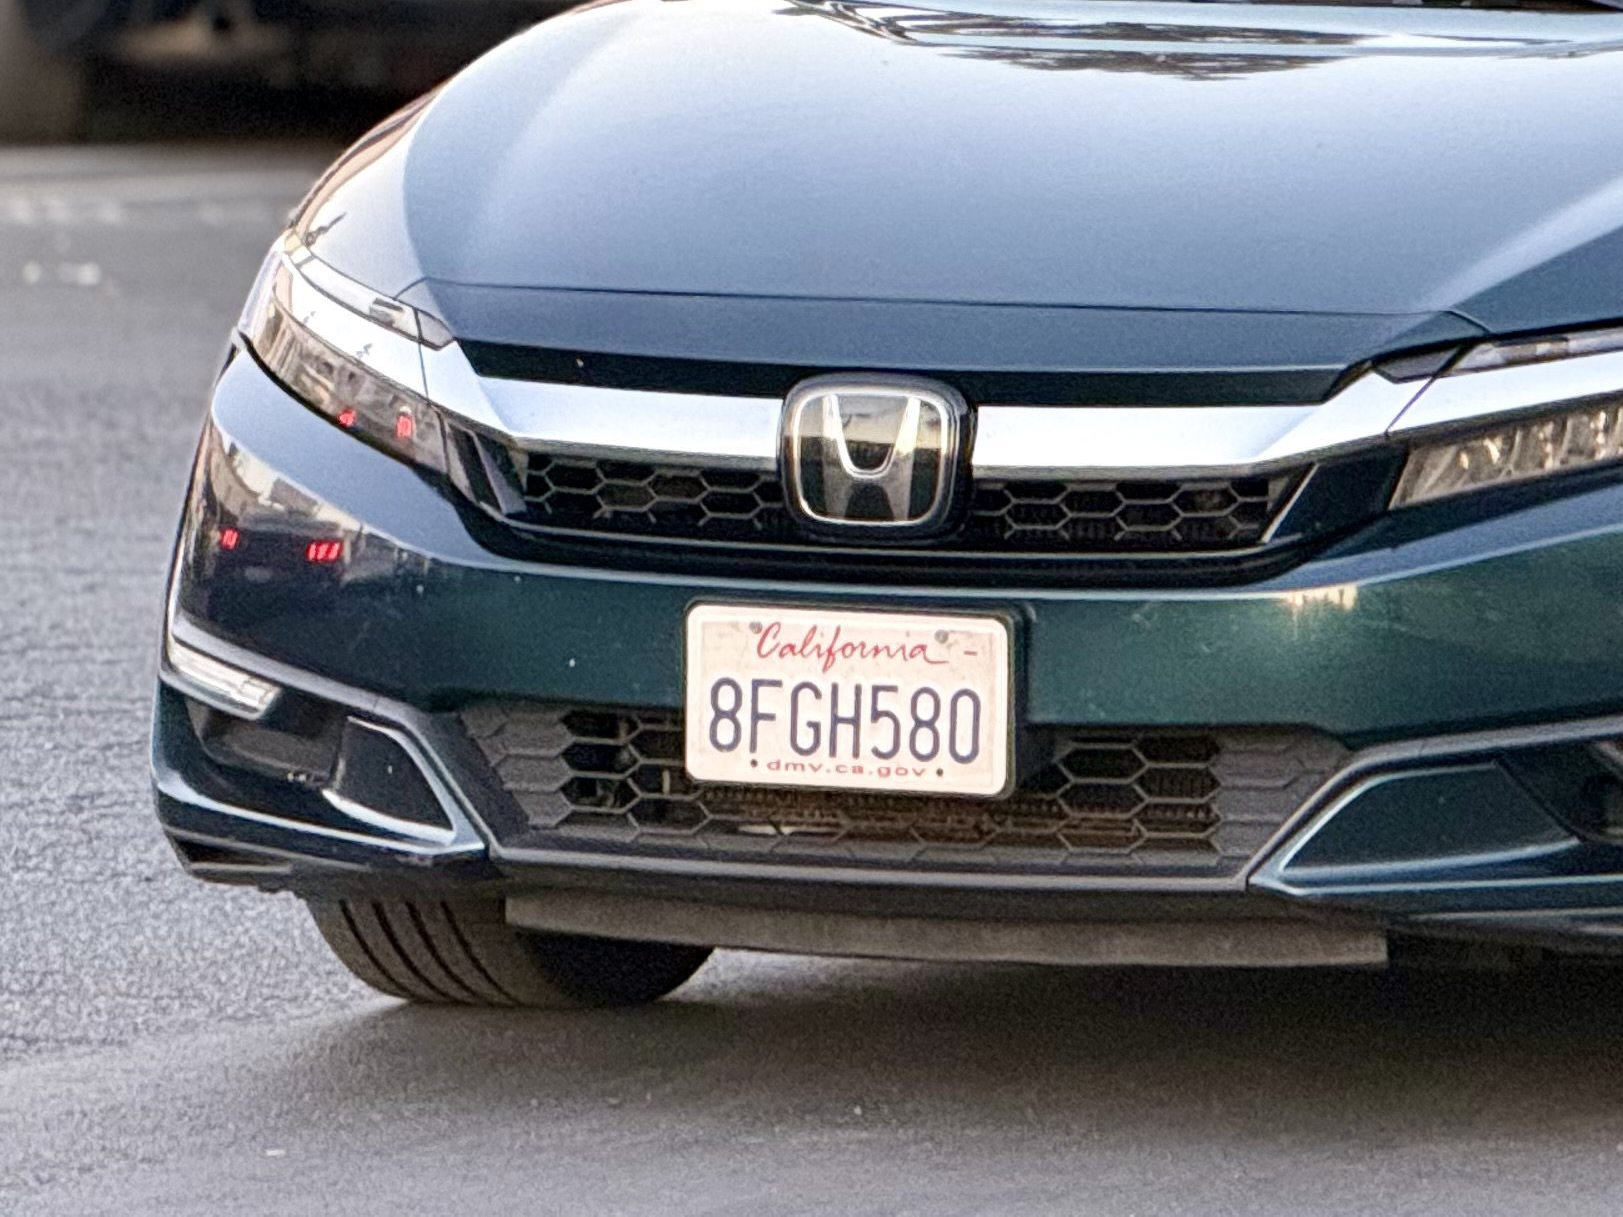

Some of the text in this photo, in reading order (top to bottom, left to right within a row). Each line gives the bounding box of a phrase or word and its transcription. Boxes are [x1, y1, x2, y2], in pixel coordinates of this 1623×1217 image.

[756, 621, 950, 673] California
[708, 676, 982, 765] 8FGH580
[766, 758, 927, 778] dmv.ca.gov
